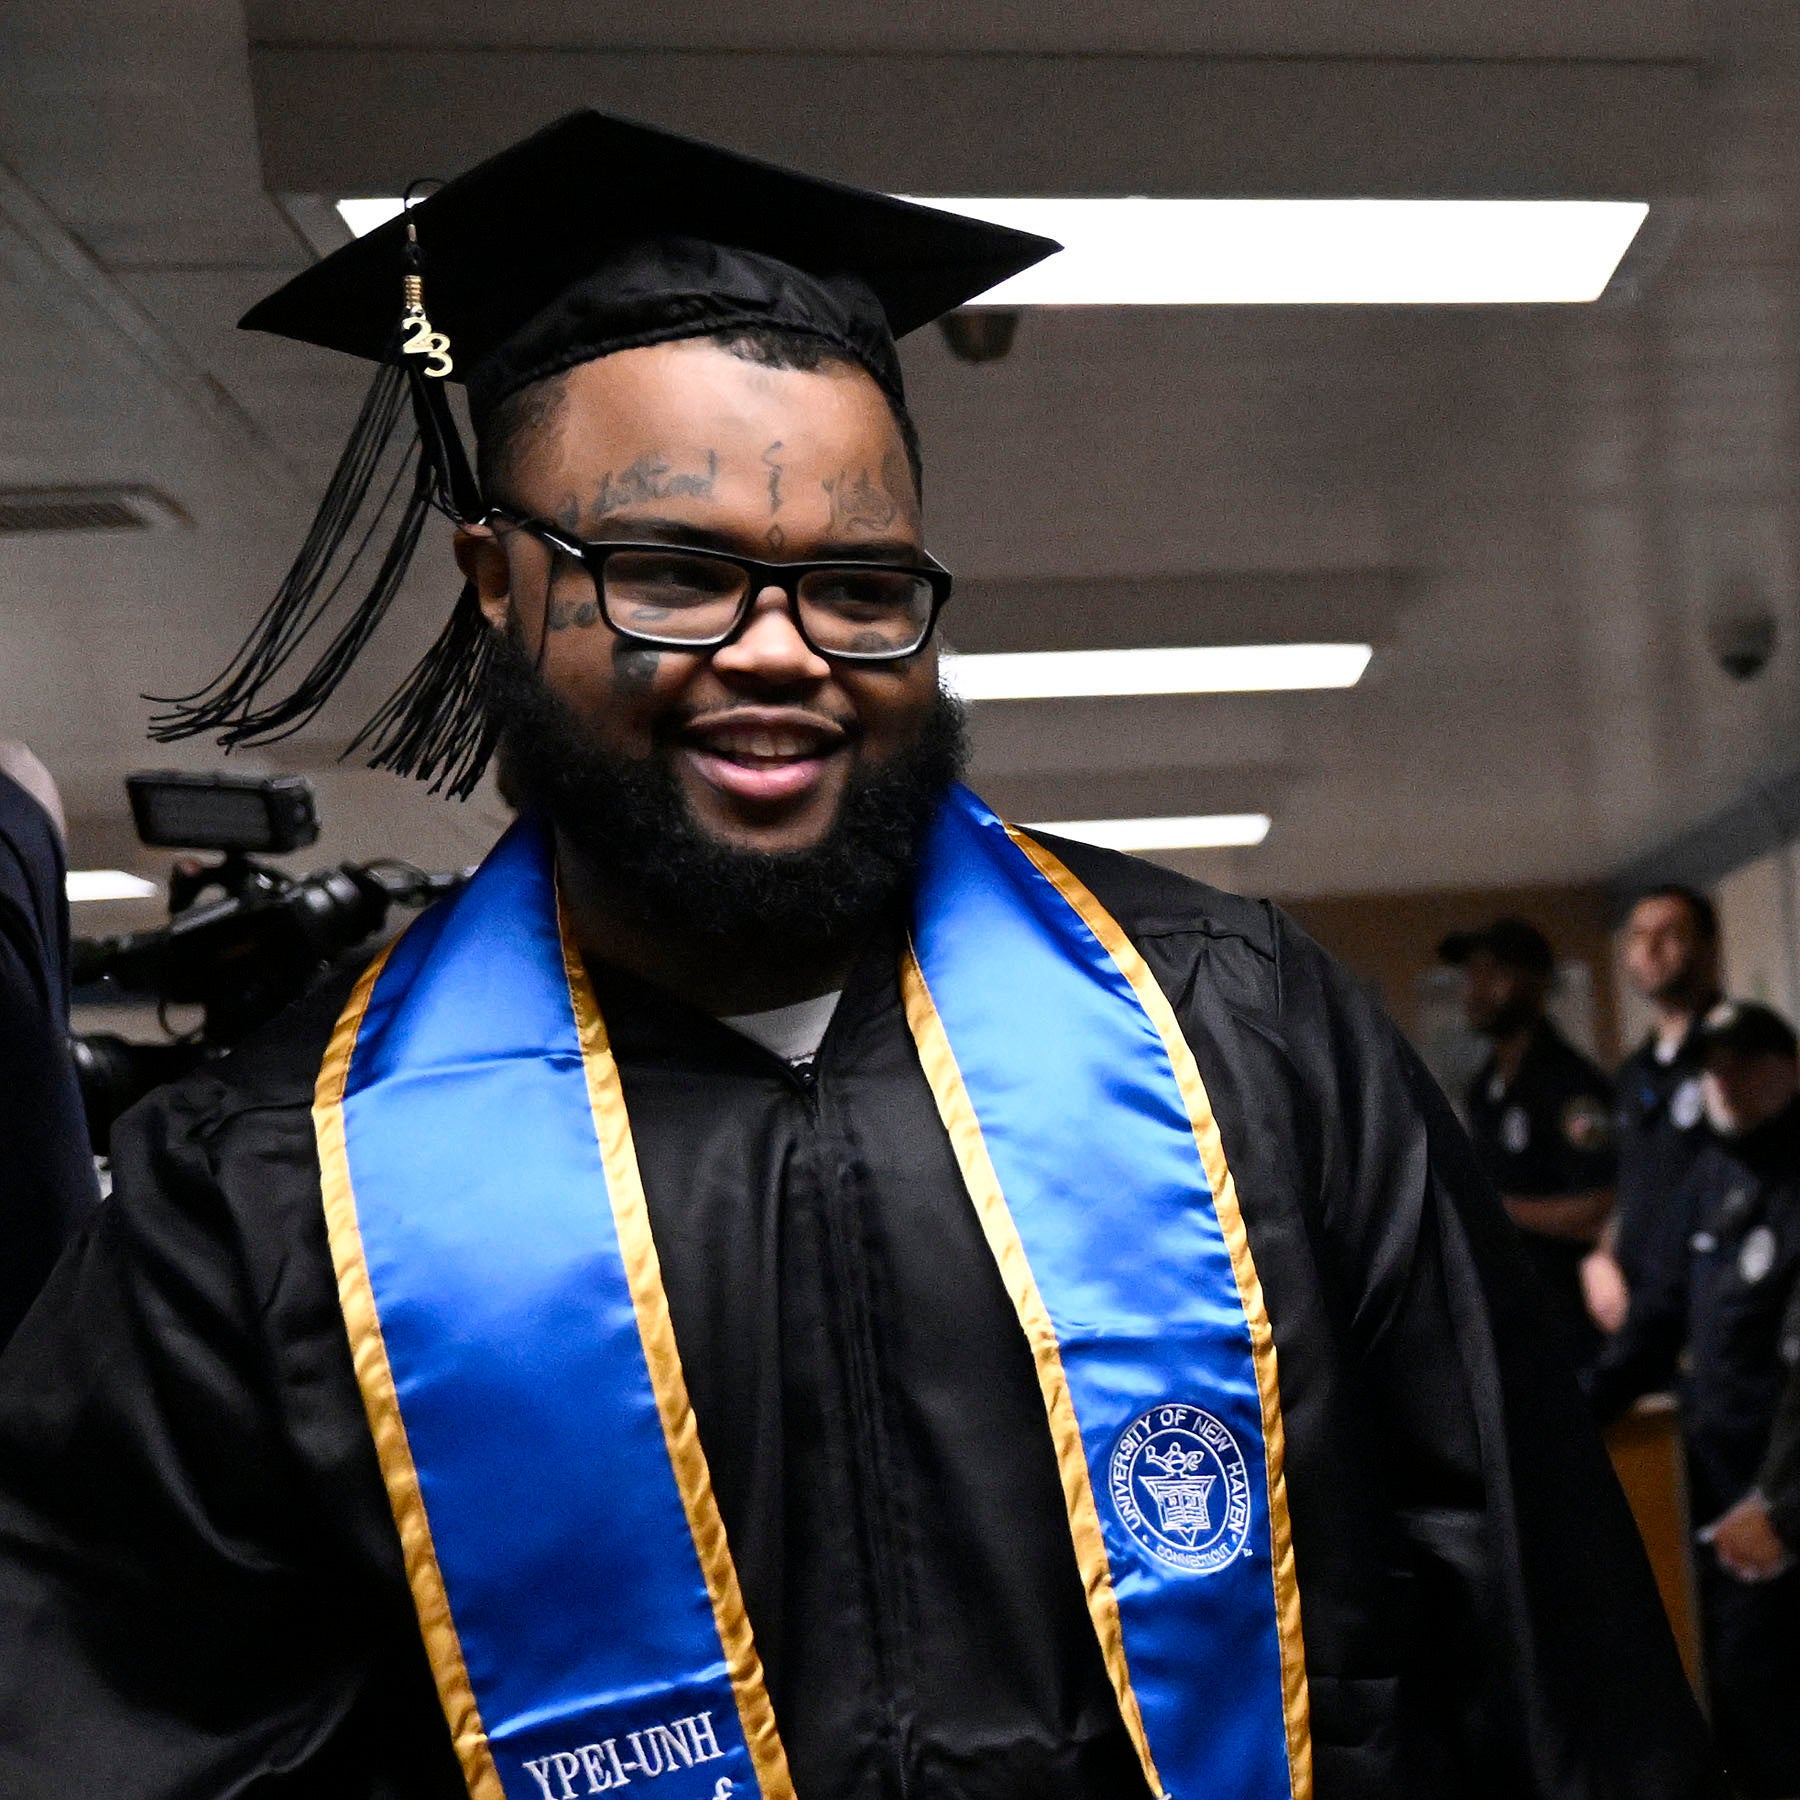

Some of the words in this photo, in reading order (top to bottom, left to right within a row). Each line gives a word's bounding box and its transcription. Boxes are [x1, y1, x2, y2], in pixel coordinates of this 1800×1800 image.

[402, 317, 453, 377] 23
[1112, 1415, 1152, 1530] UNIVERSITY
[1160, 1409, 1188, 1427] OF
[1192, 1416, 1233, 1453] NEW
[1226, 1462, 1248, 1536] HAVEN
[1156, 1542, 1231, 1568] CONNECTICUT
